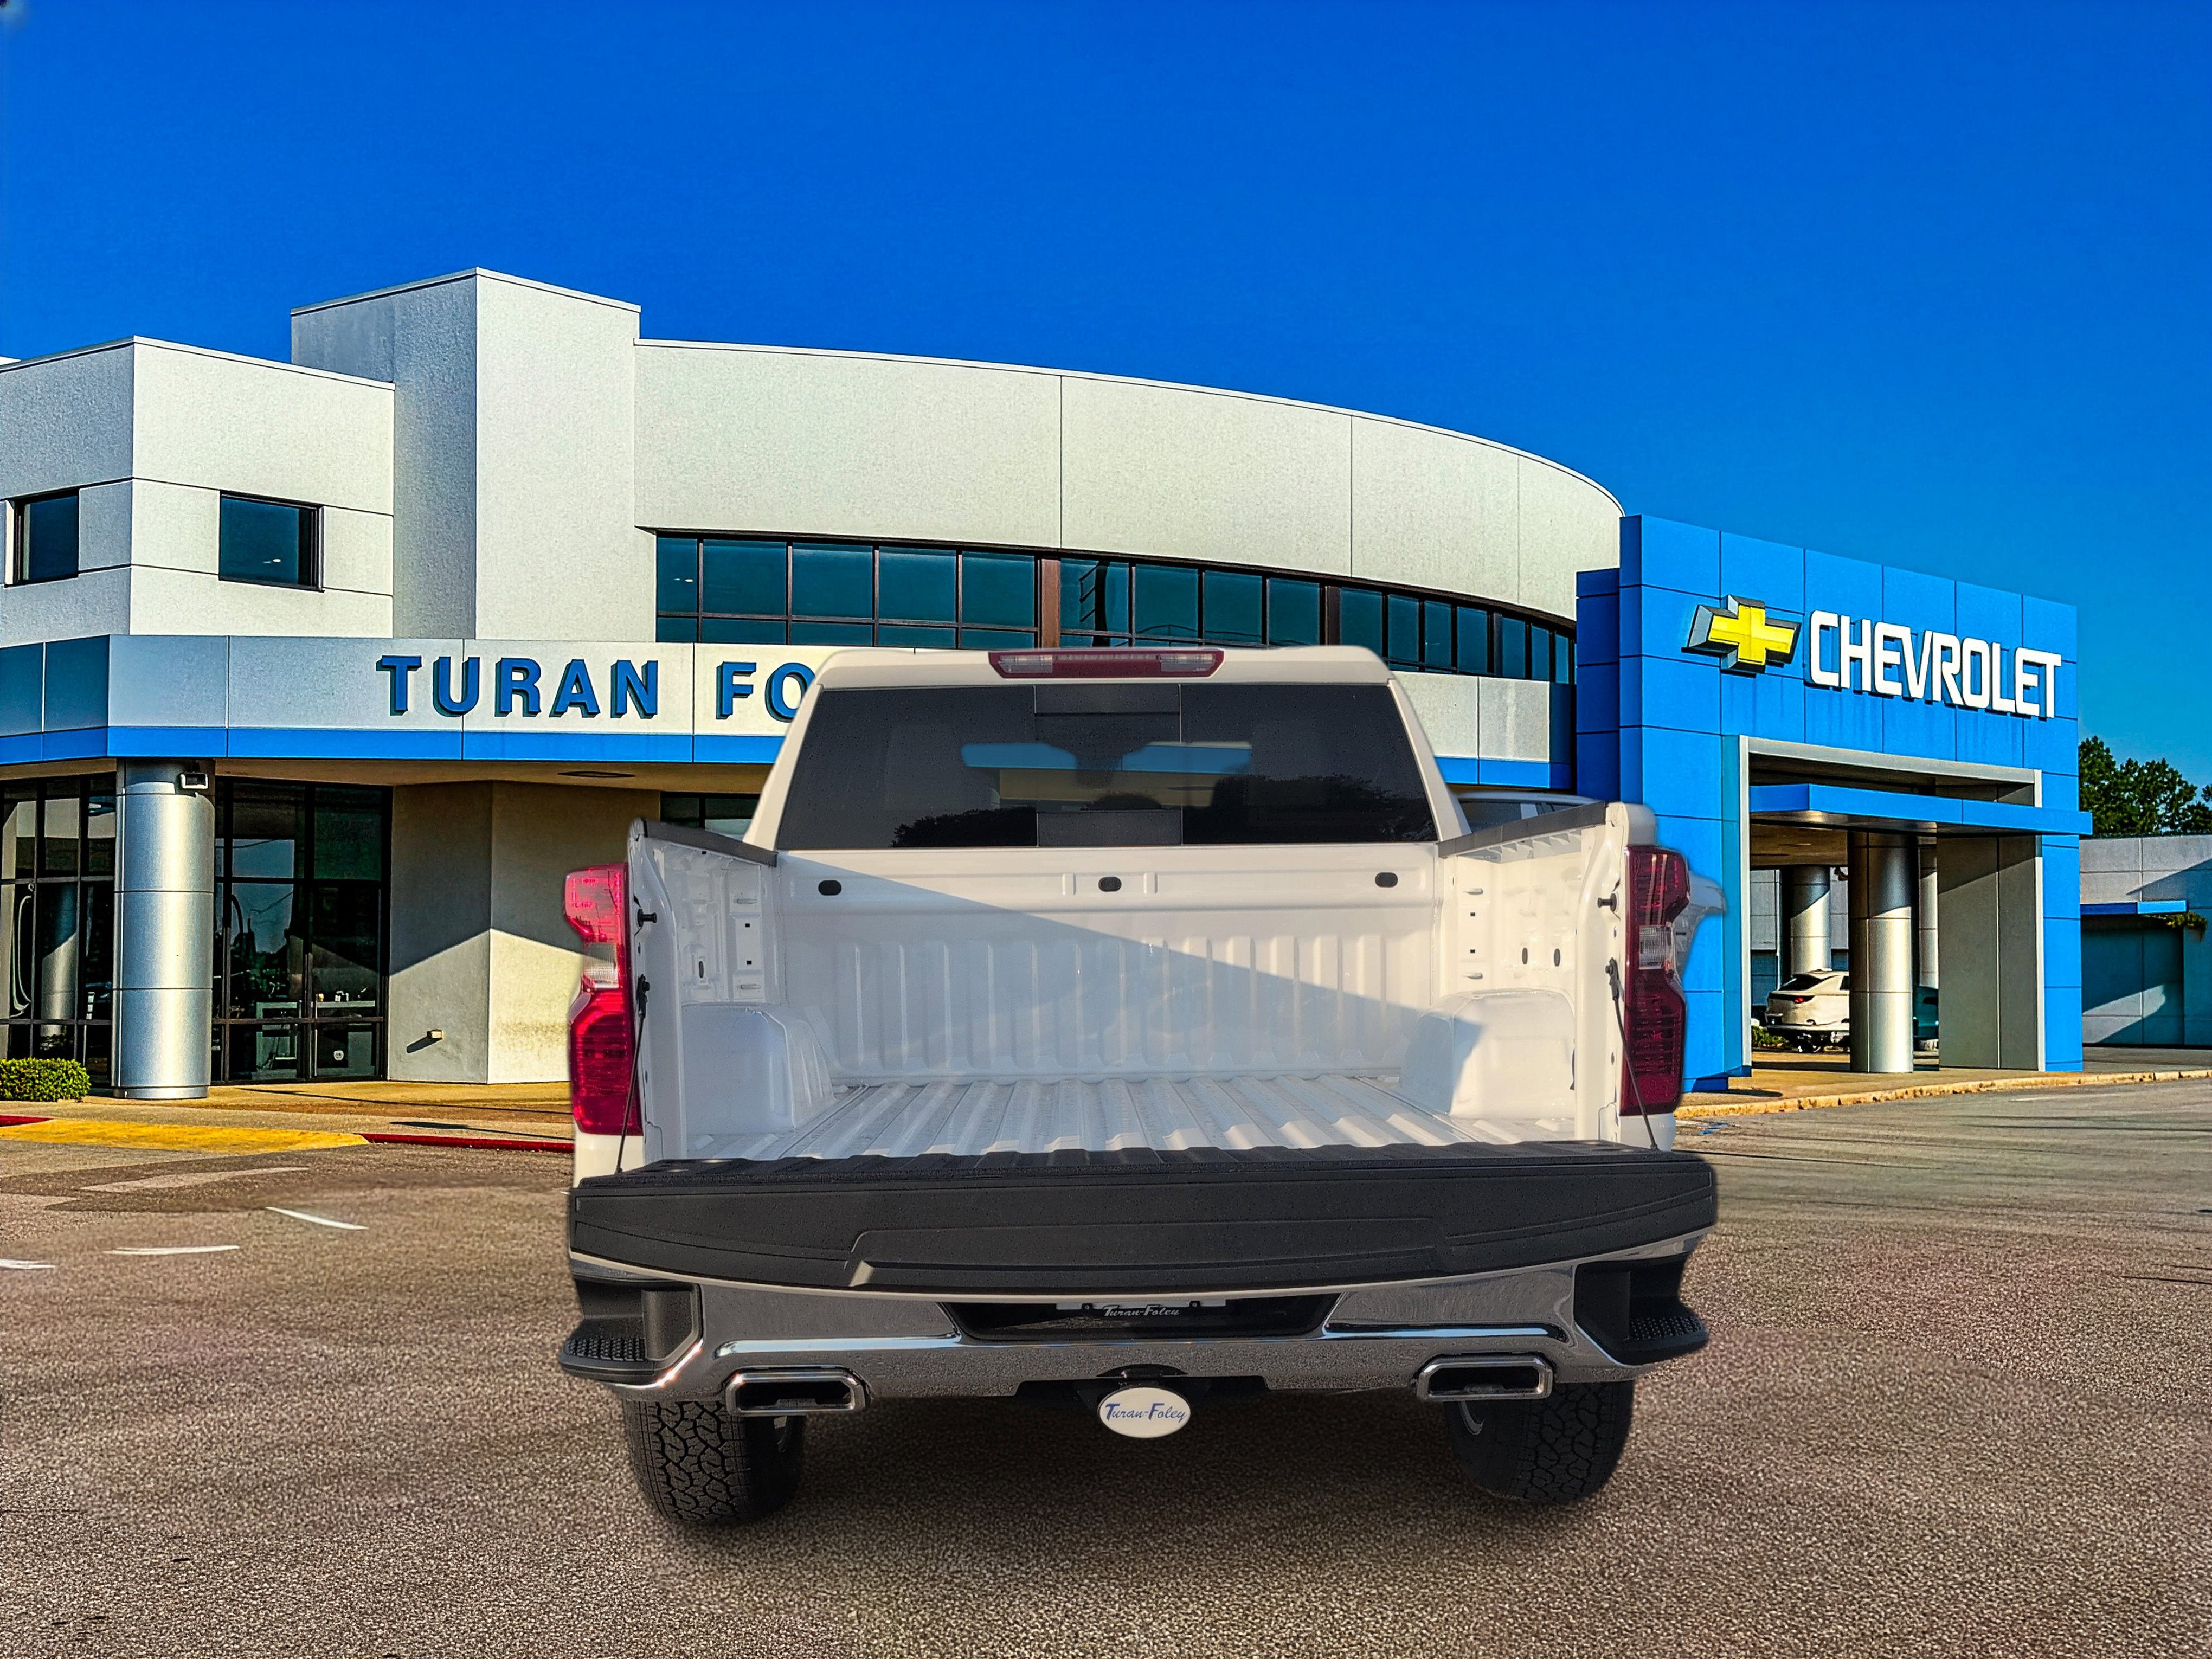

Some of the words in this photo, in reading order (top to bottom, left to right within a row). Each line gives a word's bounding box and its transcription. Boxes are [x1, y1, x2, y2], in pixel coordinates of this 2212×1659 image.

[1810, 610, 2062, 718] CHEVROLET
[376, 655, 658, 719] TURAN
[1103, 1305, 1180, 1316] Turan-Foley
[1105, 1403, 1187, 1423] Turan-Foley
